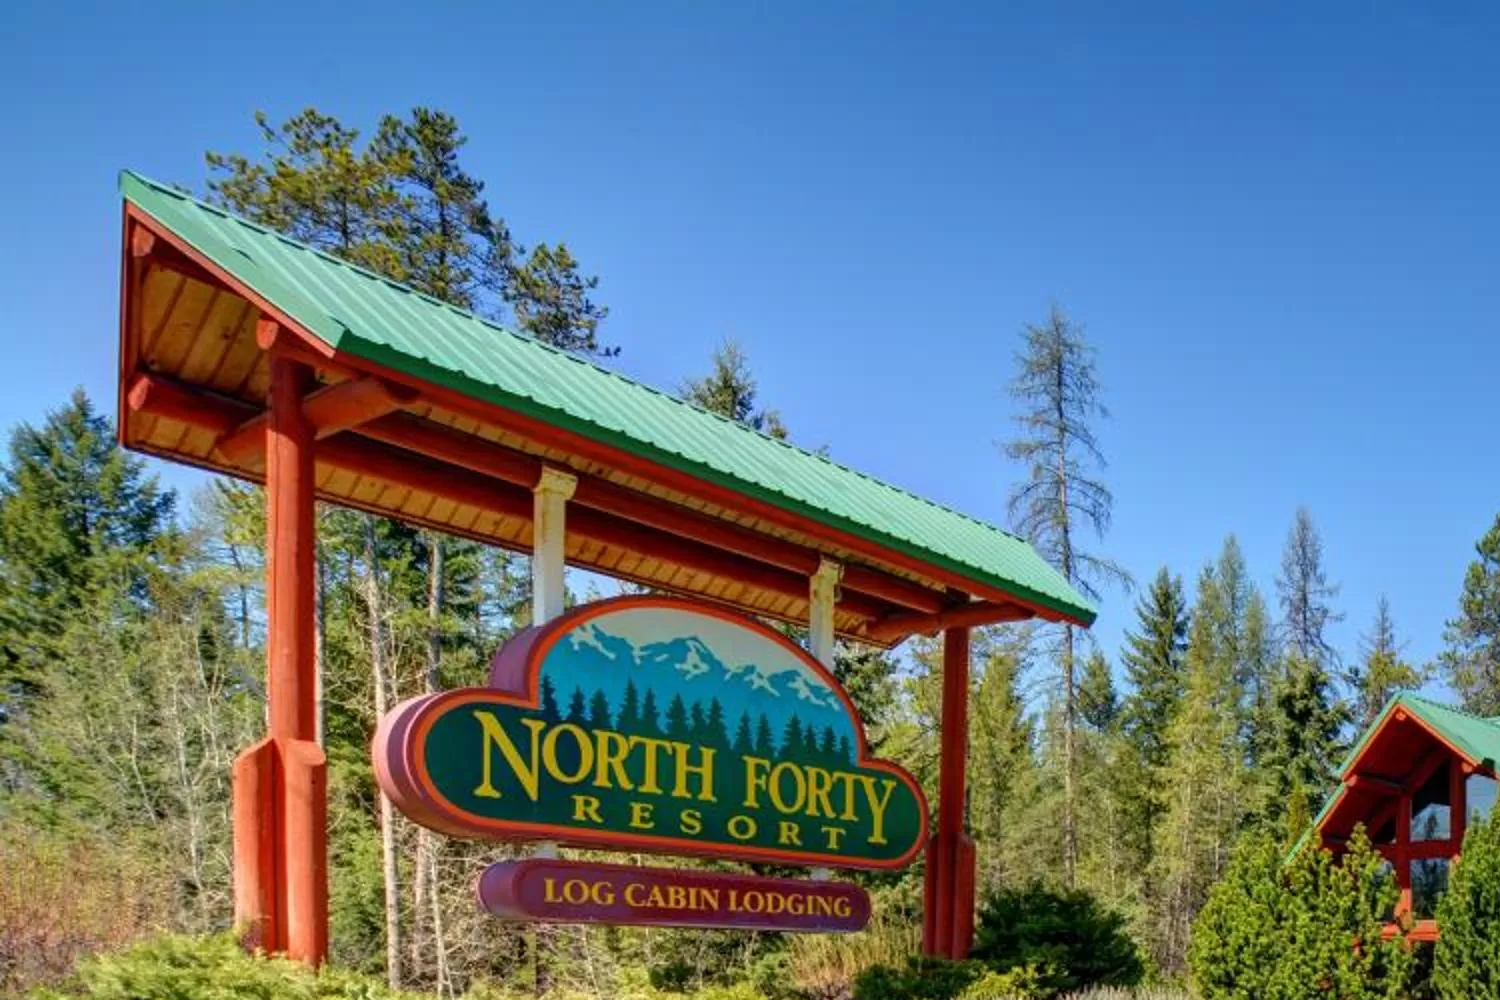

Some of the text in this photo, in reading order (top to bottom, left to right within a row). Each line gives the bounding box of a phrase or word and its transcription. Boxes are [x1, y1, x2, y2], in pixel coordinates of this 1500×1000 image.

[474, 710, 896, 845] NORTH FORTY
[571, 795, 846, 851] RESORT
[543, 878, 852, 918] LOG CABIN LODGING
